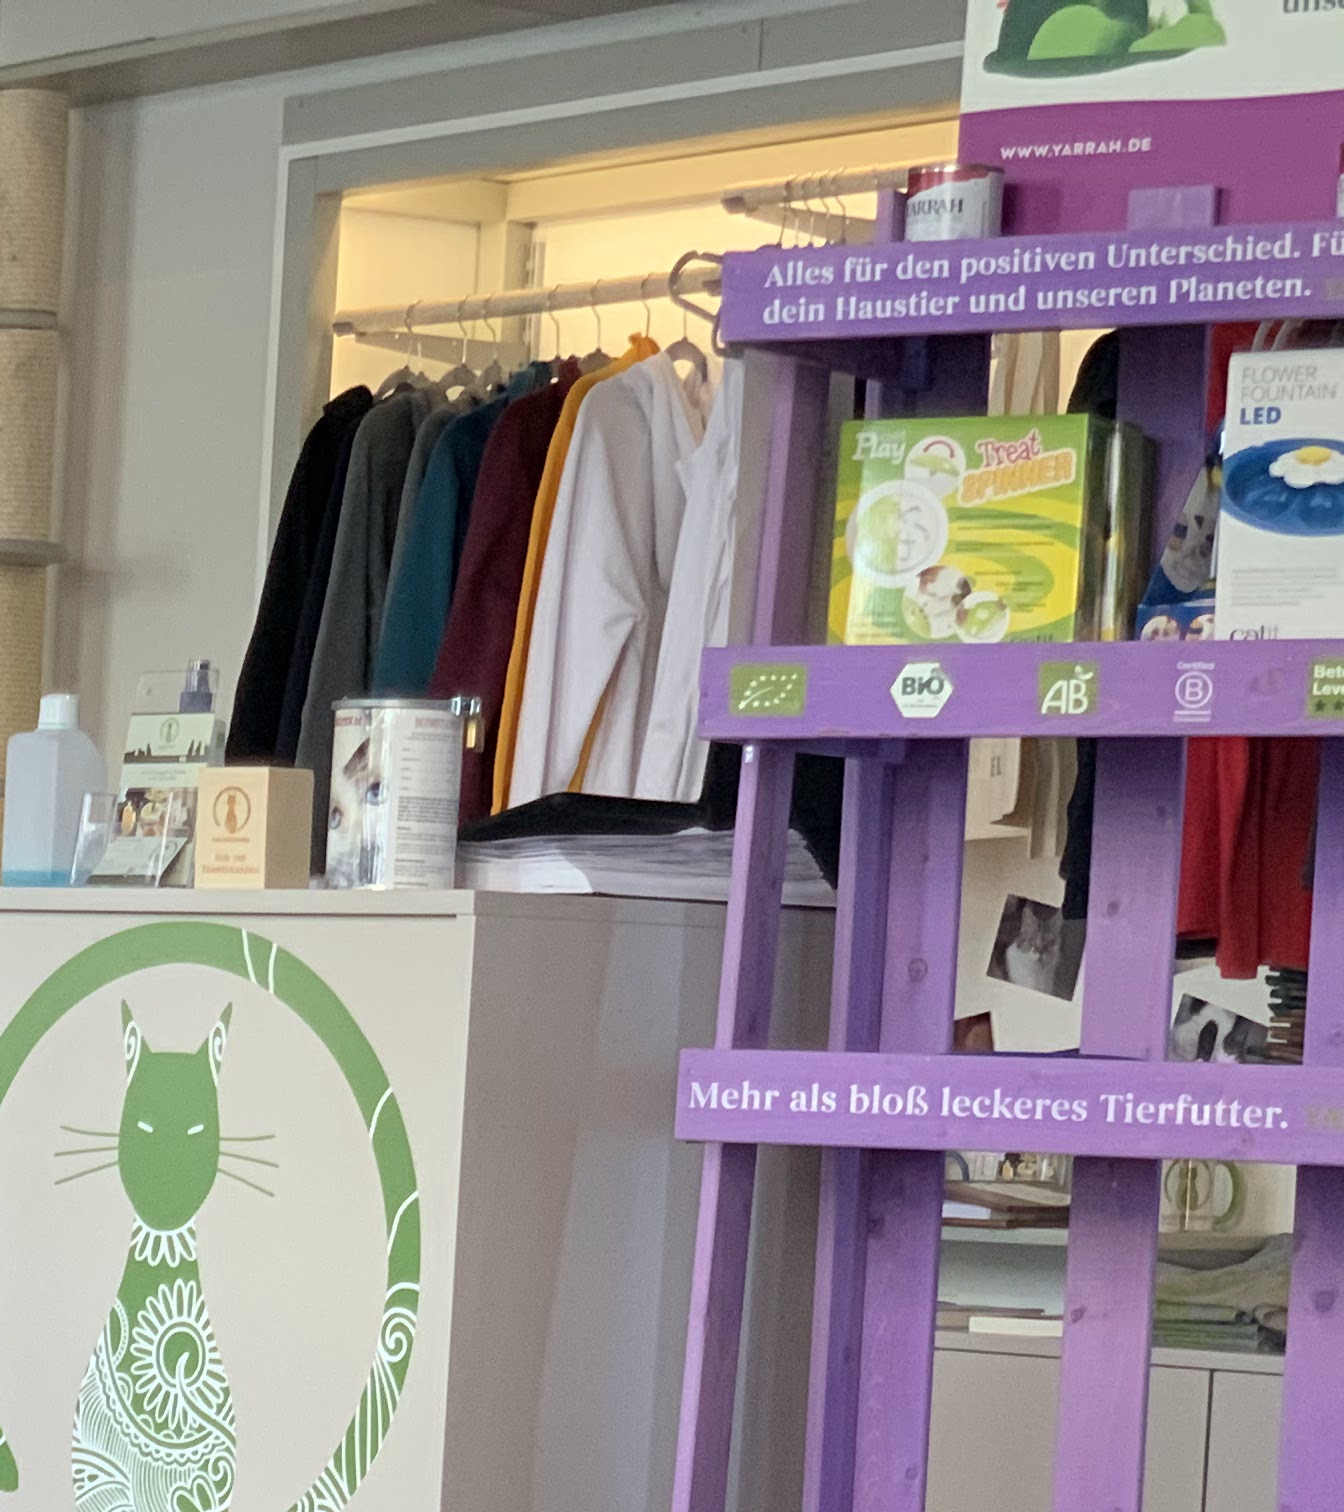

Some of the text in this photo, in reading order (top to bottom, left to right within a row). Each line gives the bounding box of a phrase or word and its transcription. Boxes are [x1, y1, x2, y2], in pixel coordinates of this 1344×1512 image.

[1000, 138, 1152, 160] WWW.YARRAH.DE
[764, 260, 835, 288] Alles
[843, 256, 888, 283] für
[896, 254, 950, 280] den
[959, 246, 1095, 284] positiven
[1107, 232, 1301, 269] Unterschied.
[763, 275, 1312, 325] dein Haustier und unseren Planeten.
[1242, 365, 1318, 383] FLOWER
[1240, 383, 1337, 403] FOUNTAIN
[1239, 406, 1282, 426] LED
[852, 432, 906, 465] Play
[977, 428, 1041, 469] Treat
[1313, 664, 1344, 679] Bet
[688, 1080, 1289, 1130] Mehr als bloß leckeres Tierfutter.
